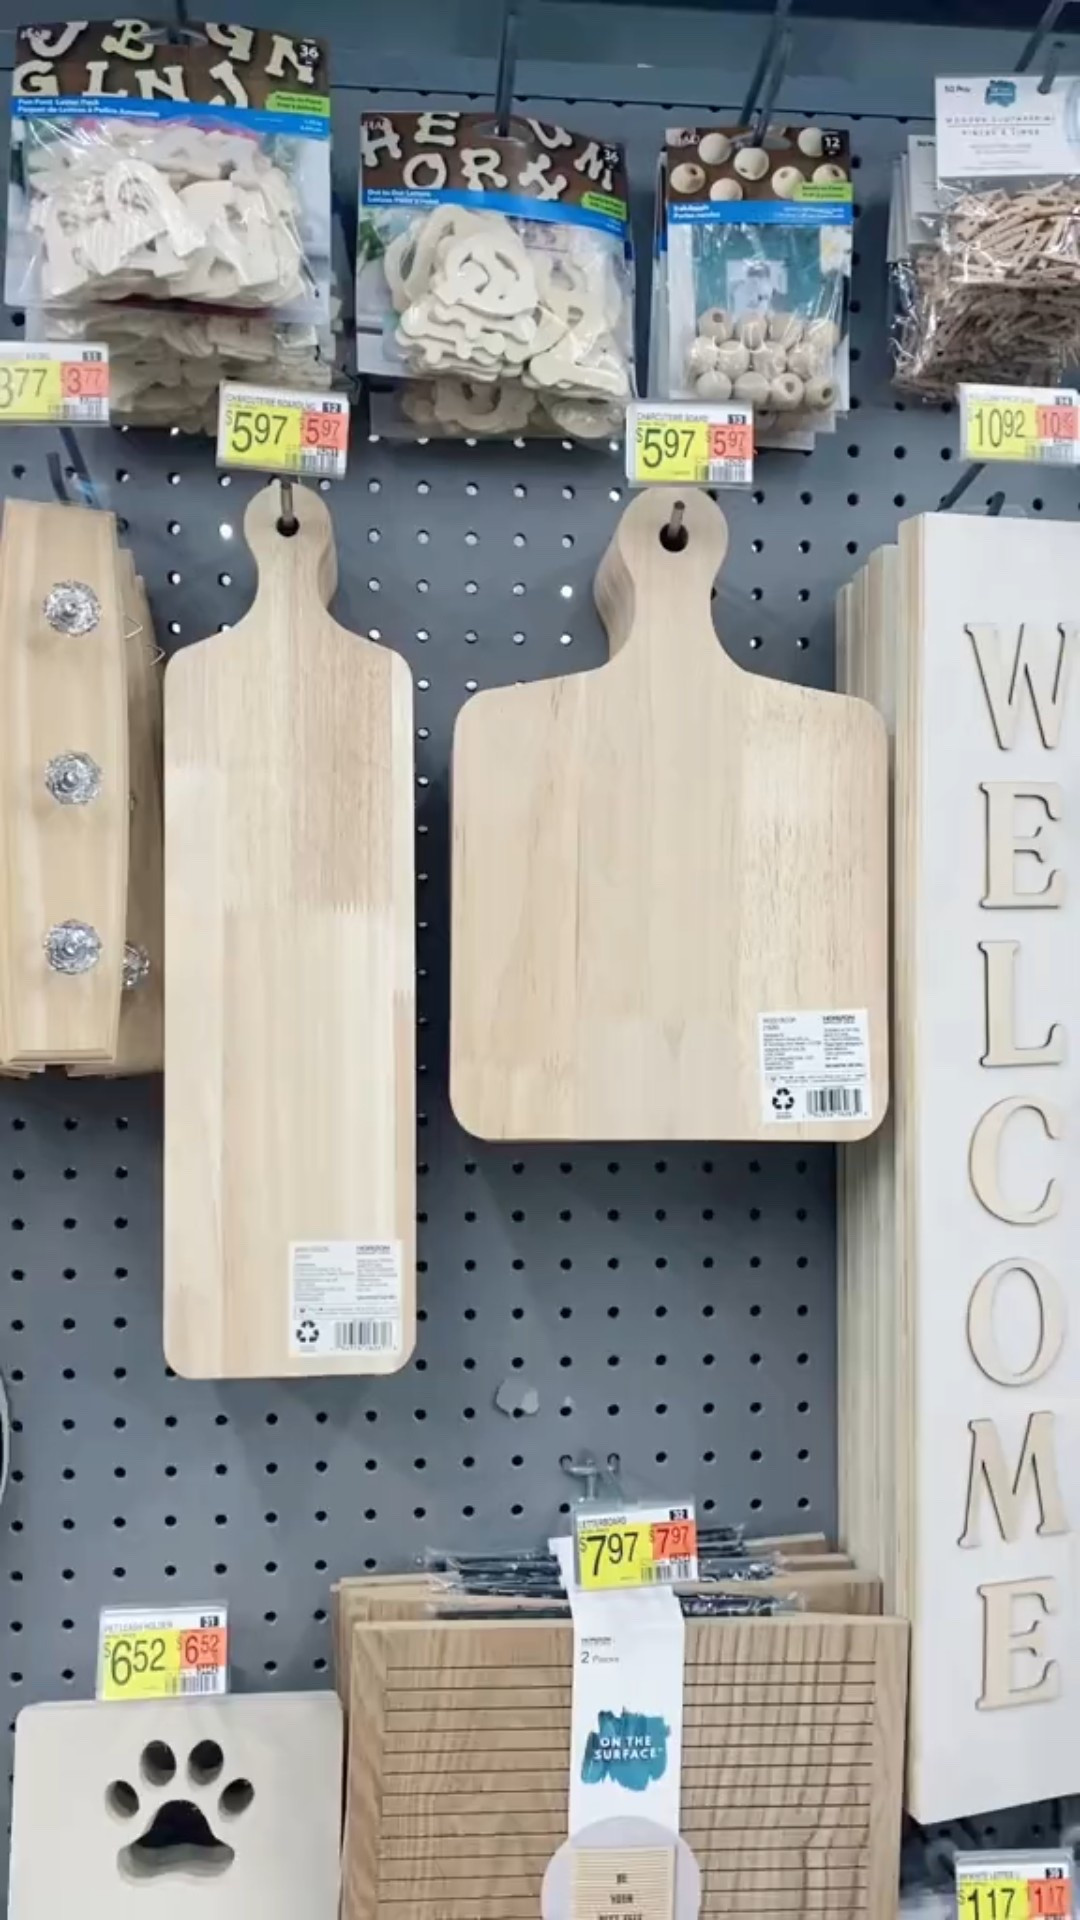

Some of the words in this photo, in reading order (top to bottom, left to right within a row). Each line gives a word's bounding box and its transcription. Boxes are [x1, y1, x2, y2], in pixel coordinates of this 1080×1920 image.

[299, 44, 319, 60] 36
[824, 136, 840, 148] 12
[226, 409, 288, 453] $597
[636, 427, 696, 468] $597
[957, 622, 1078, 1712] WELCOME
[580, 1532, 638, 1576] $797
[104, 1638, 166, 1686] $652
[581, 1651, 590, 1664] 2
[600, 1737, 622, 1747] ON
[627, 1735, 652, 1746] THE
